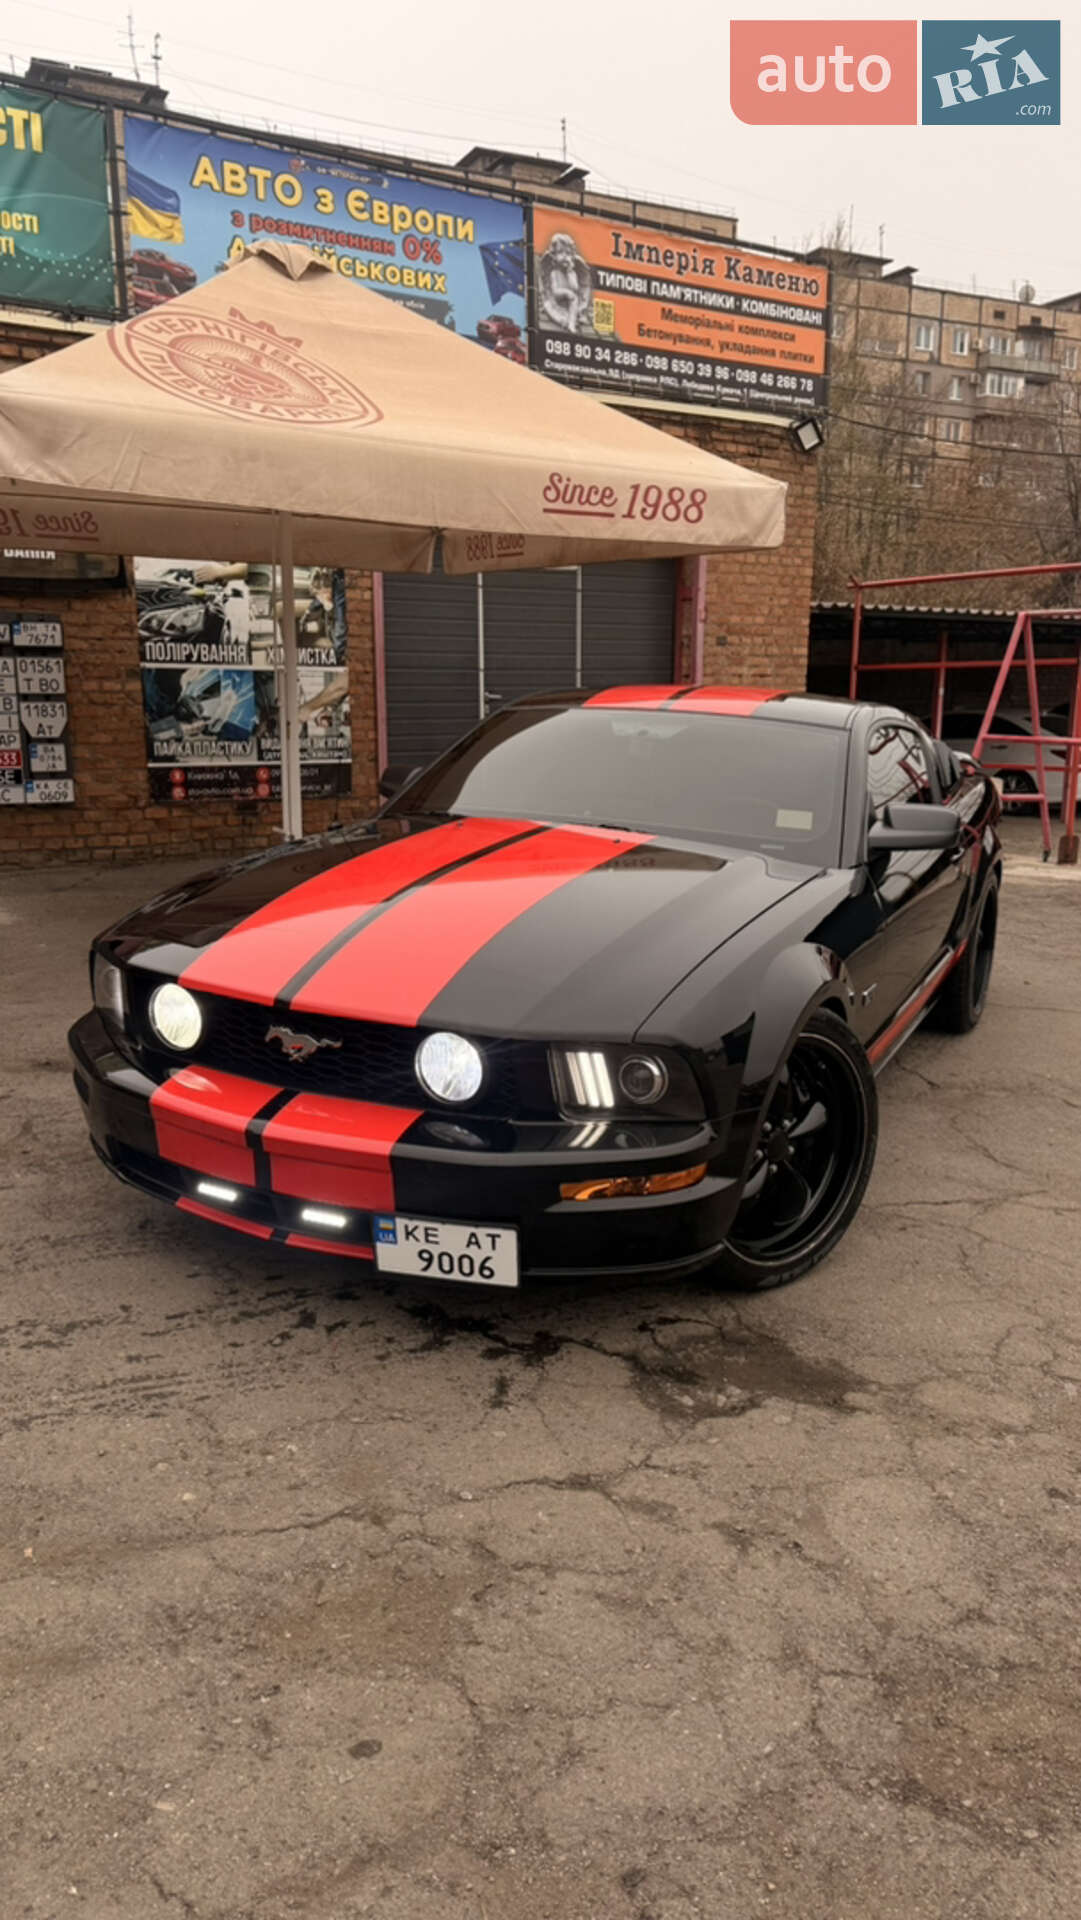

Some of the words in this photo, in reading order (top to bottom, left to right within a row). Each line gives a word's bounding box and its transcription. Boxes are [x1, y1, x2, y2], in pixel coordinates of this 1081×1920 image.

[191, 155, 302, 207] АВТО
[315, 187, 336, 215] з
[346, 189, 475, 243] Європи
[250, 214, 396, 256] розмитненням
[402, 234, 443, 264] 0%
[611, 231, 715, 276] Імперія
[724, 255, 820, 296] Каменю
[597, 271, 648, 294] ТИПОВІ
[651, 281, 735, 309] ПАМ'ЯТНИКИ
[741, 298, 822, 325] КОМБІНОВАНІ
[737, 324, 796, 342] комплекси
[545, 339, 571, 355] 098
[574, 344, 591, 359] 90
[594, 347, 611, 361] 34
[645, 355, 669, 370] 098
[671, 359, 694, 374] 650
[697, 363, 712, 377] 39
[736, 369, 757, 384] 098
[800, 378, 814, 392] 78
[542, 472, 618, 508] Since
[621, 483, 707, 524] 1988
[27, 634, 56, 645] 7671
[145, 642, 247, 662] ПОЛІРУВАННЯ
[19, 660, 61, 674] 01561
[24, 704, 65, 718] 11831
[37, 723, 54, 736] AT
[154, 739, 193, 756] ПАЙКА
[194, 740, 253, 757] ПЛАСТИКУ
[379, 1233, 395, 1243] UA
[404, 1224, 440, 1245] KE
[466, 1231, 501, 1251] AT
[418, 1249, 495, 1280] 9006
